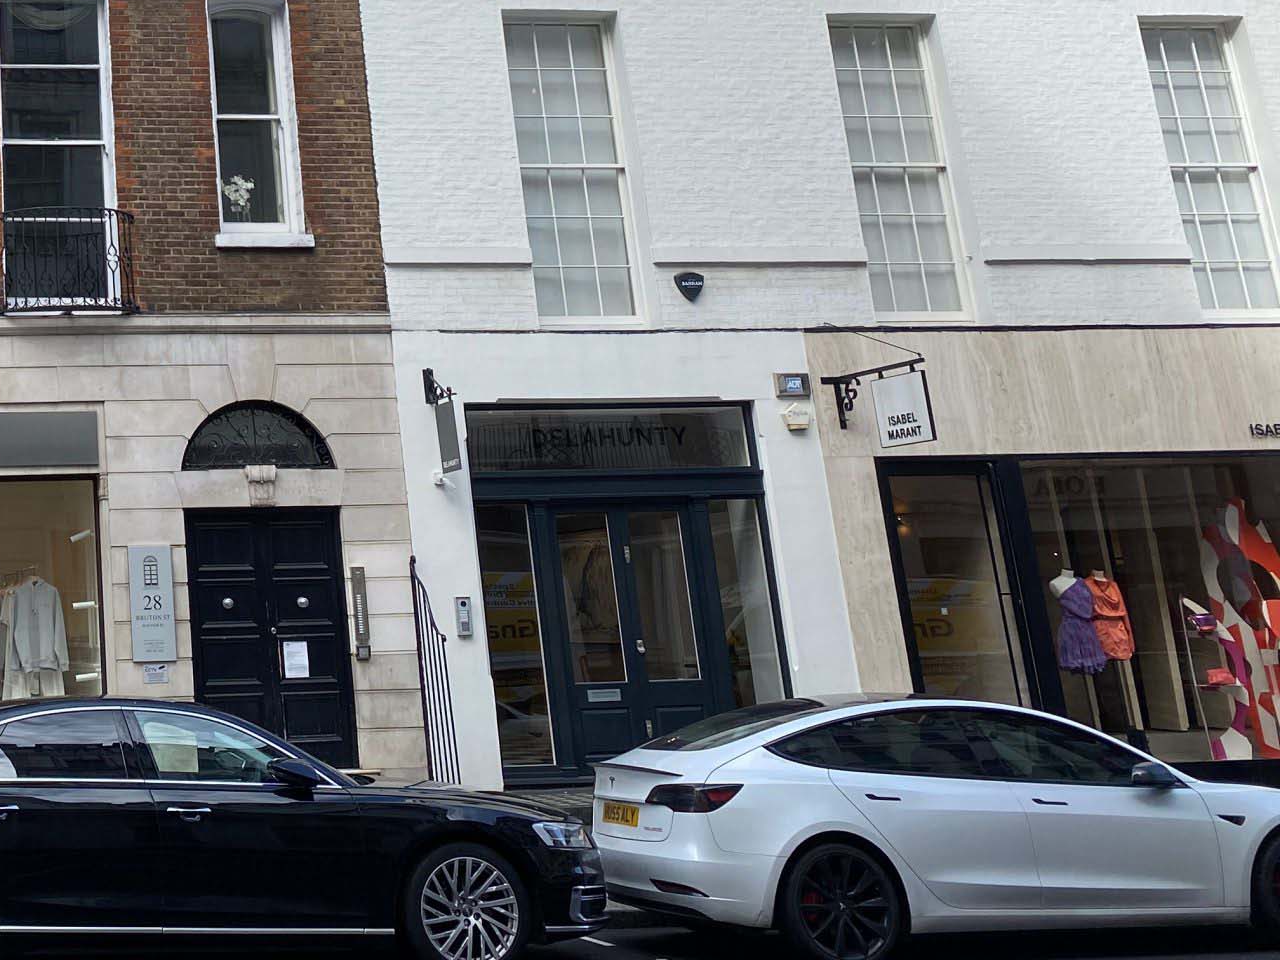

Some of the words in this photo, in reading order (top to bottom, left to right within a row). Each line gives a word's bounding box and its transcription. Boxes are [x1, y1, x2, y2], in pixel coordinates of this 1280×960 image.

[786, 380, 801, 389] ADT
[888, 412, 918, 426] ISABEL
[532, 427, 686, 448] DELAHUNTY
[888, 426, 922, 440] MARANT
[143, 595, 162, 610] 28
